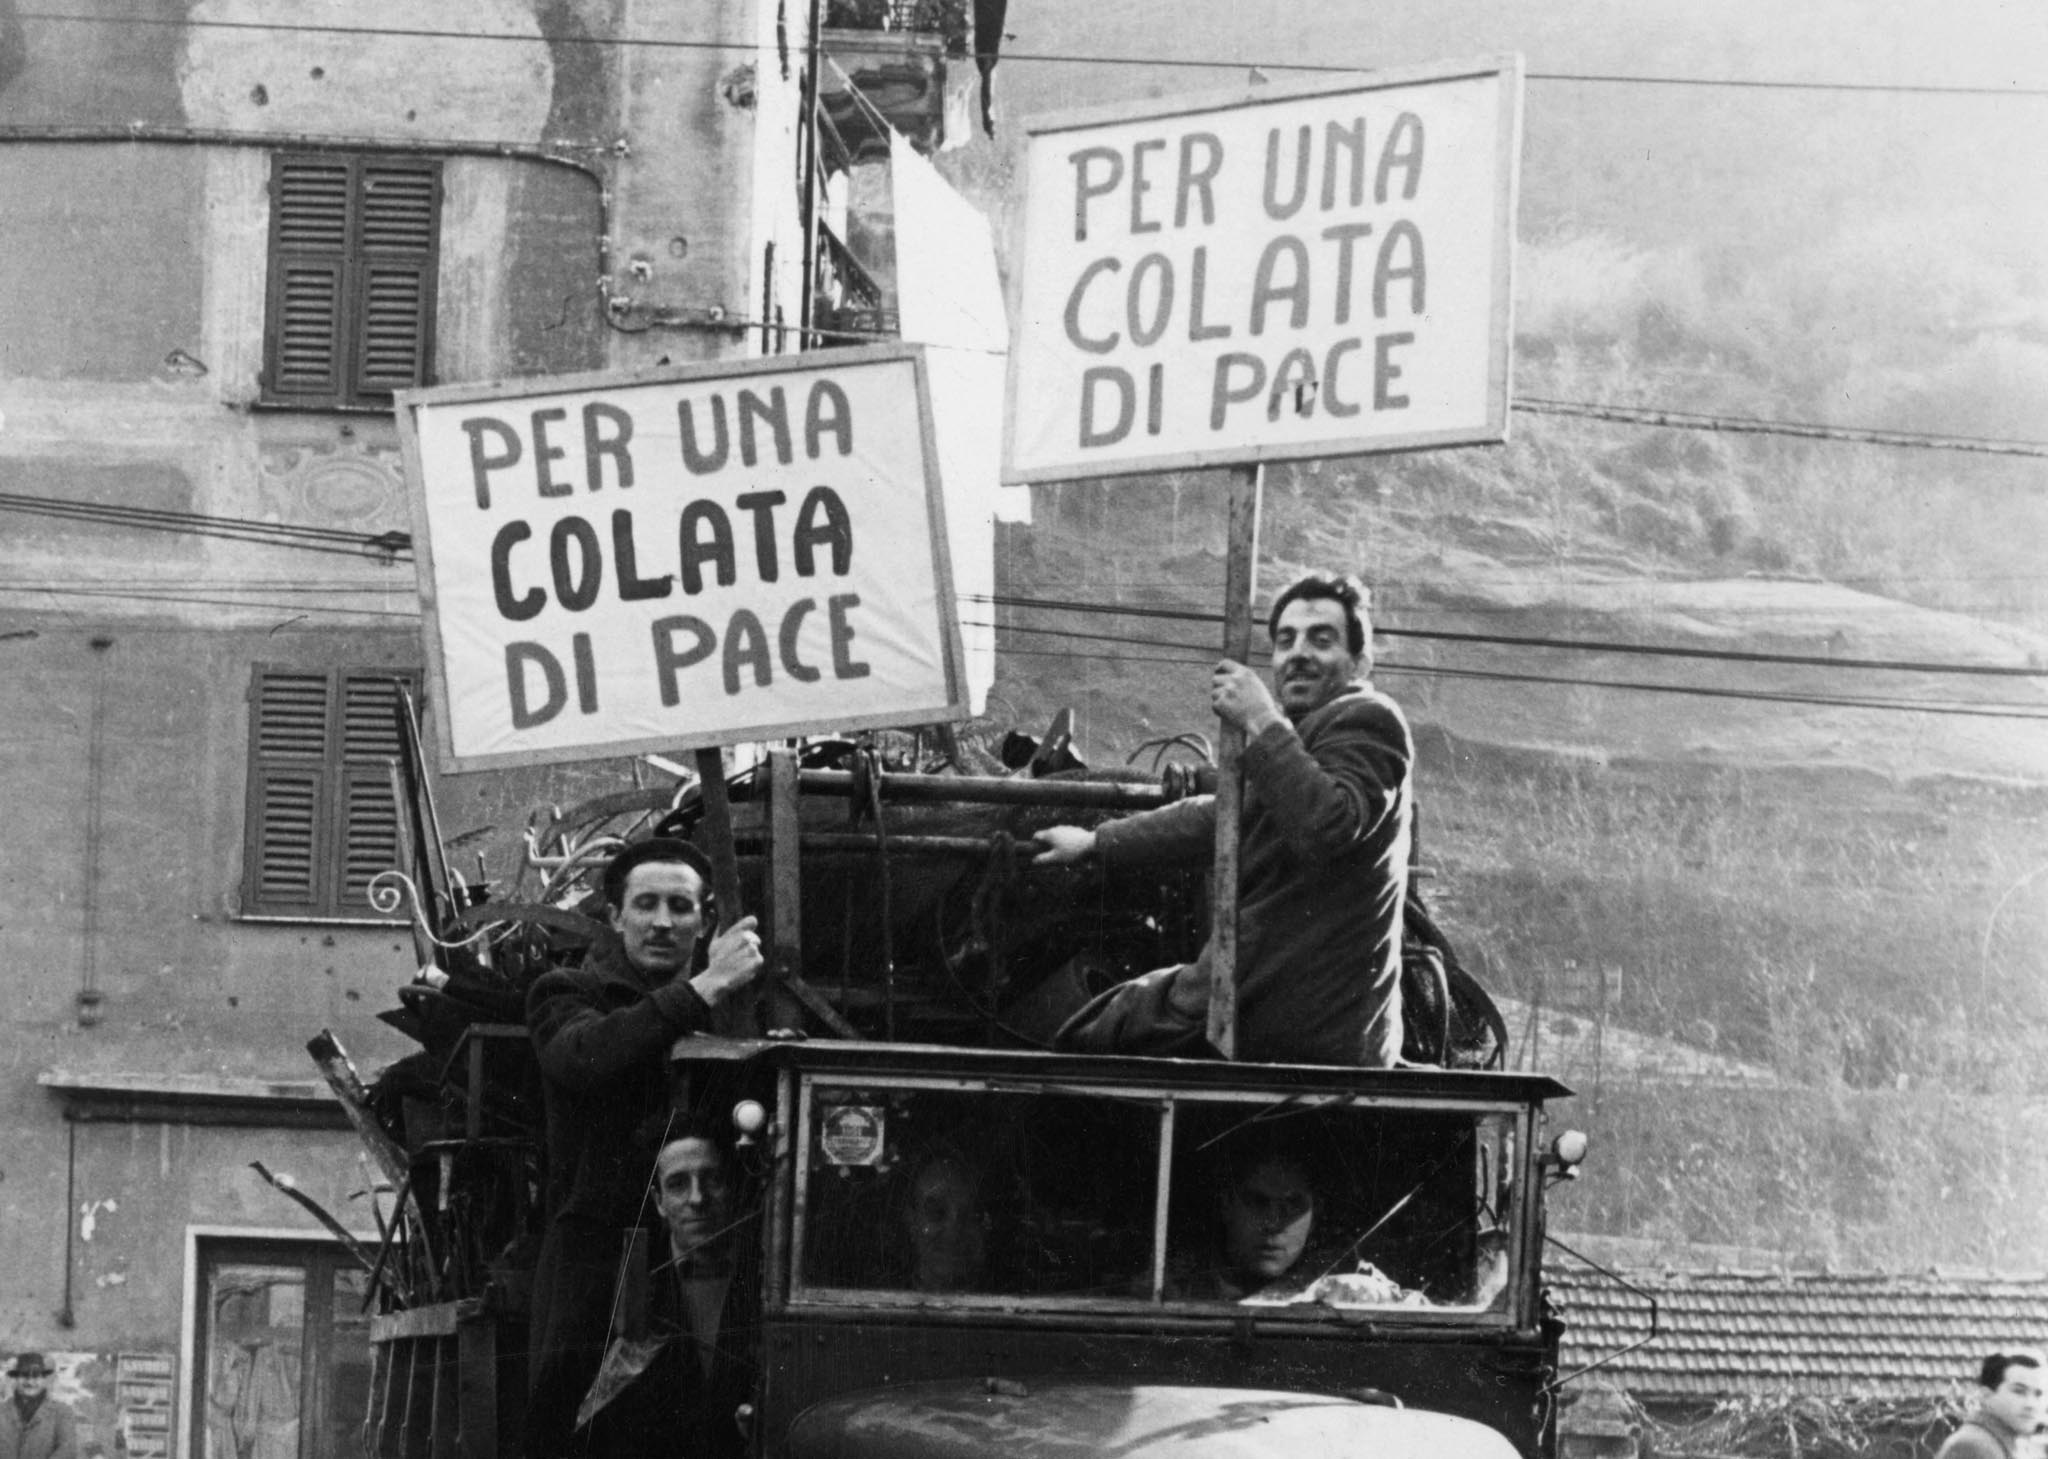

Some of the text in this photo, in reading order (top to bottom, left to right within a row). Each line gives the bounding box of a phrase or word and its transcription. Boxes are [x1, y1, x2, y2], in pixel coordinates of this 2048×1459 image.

[1068, 112, 1424, 242] PER UNA
[1063, 219, 1426, 355] COLATA
[461, 379, 853, 510] PER UNA
[1079, 332, 1415, 448] DI PACE
[490, 486, 853, 621] COLATA
[504, 593, 871, 730] DI PACE
